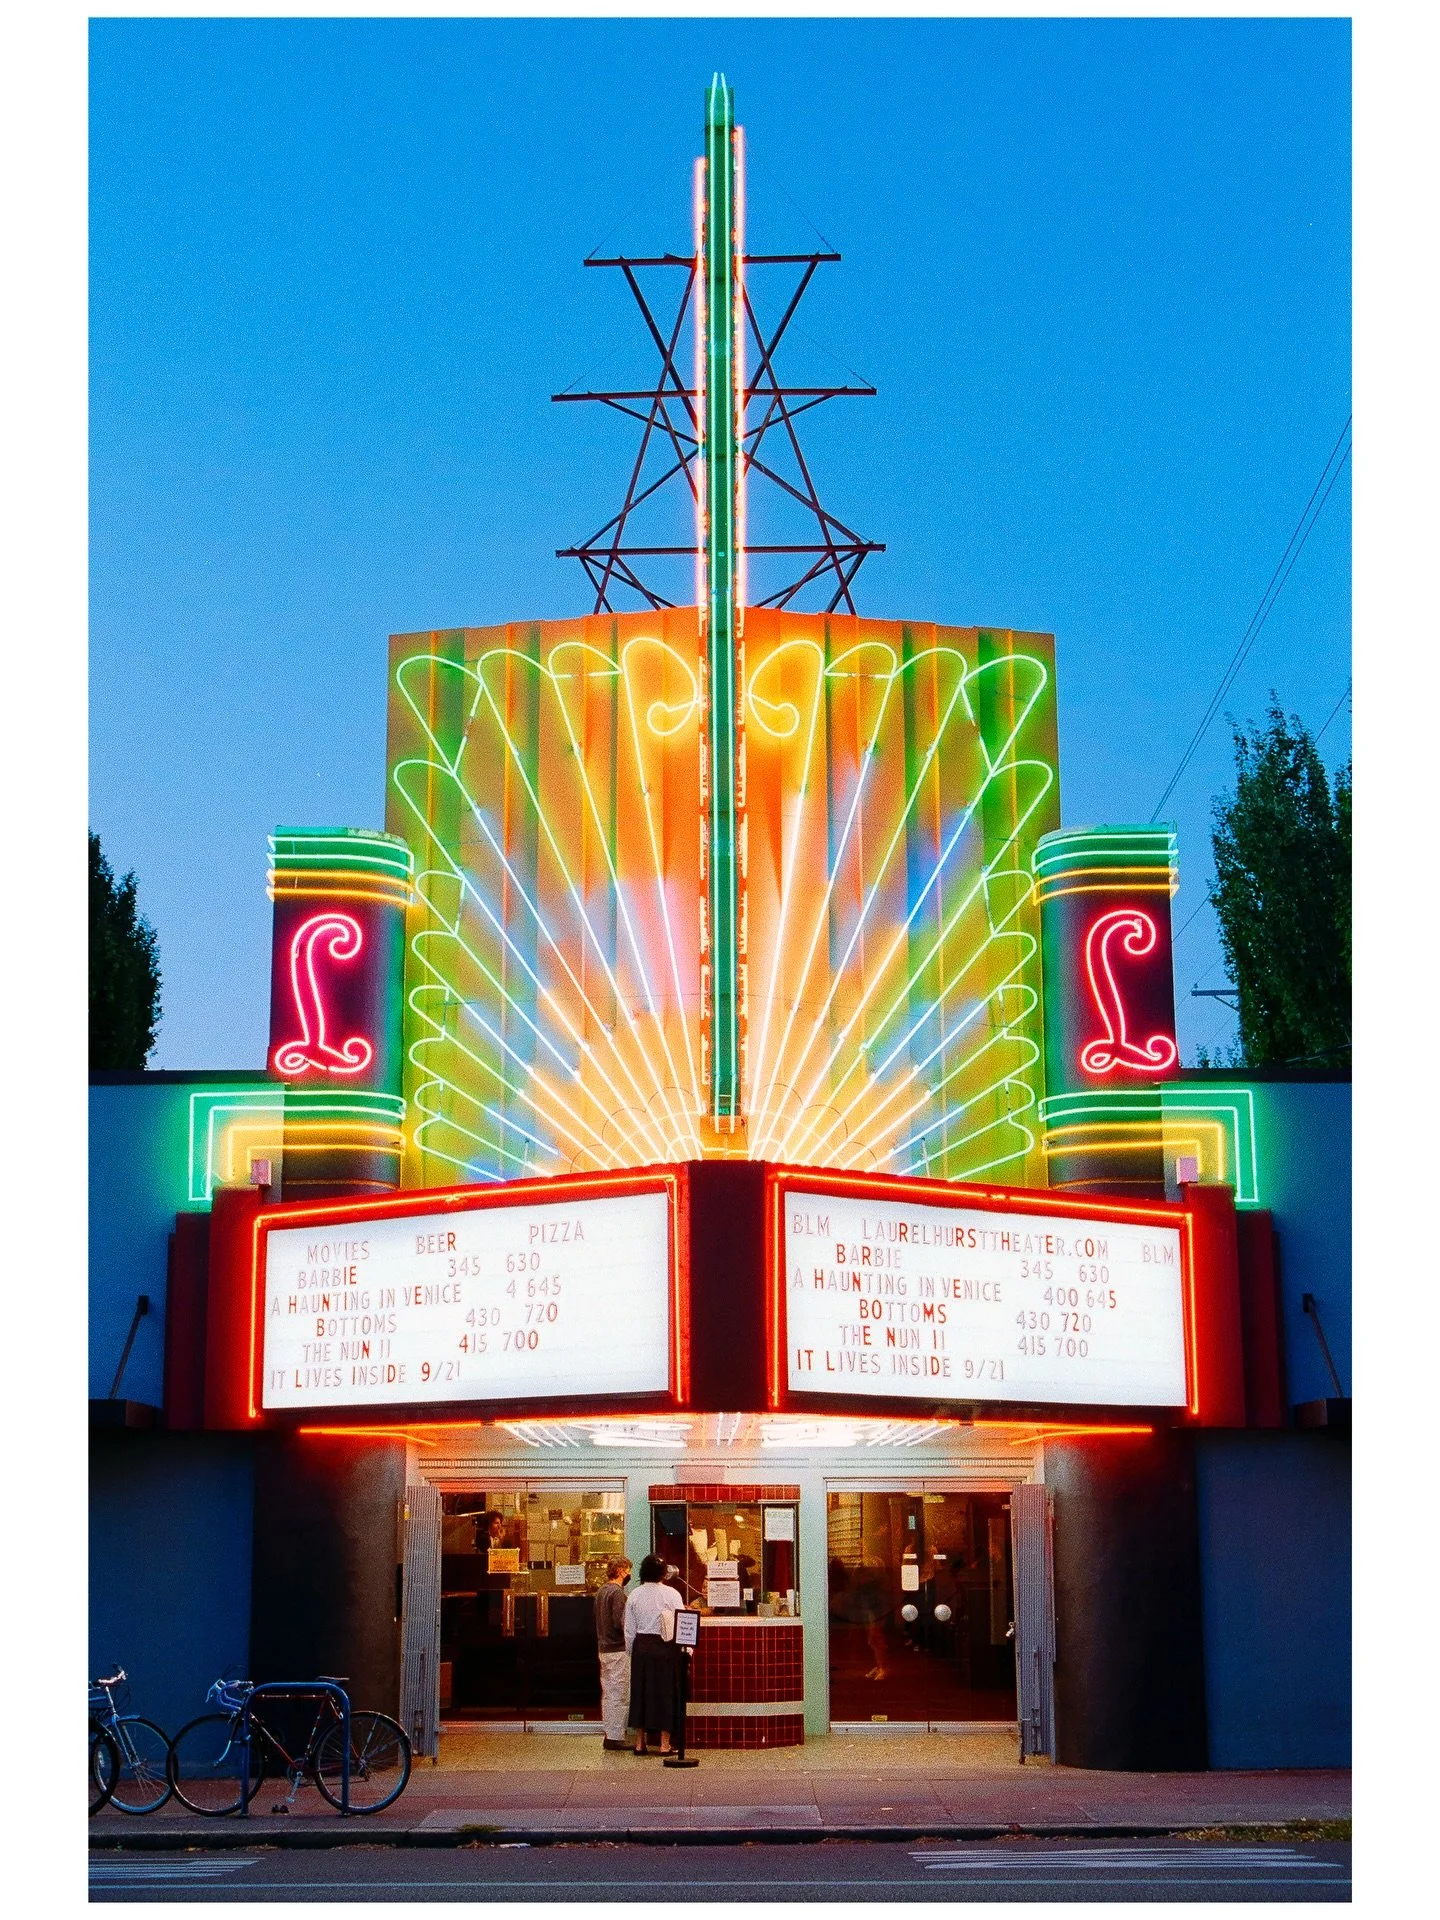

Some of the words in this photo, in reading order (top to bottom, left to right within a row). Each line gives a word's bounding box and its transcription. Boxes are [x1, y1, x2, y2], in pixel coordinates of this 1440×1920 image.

[274, 912, 372, 1074] L
[1081, 909, 1176, 1074] L
[307, 1240, 370, 1264] MOVIES
[415, 1232, 457, 1255] BEER
[528, 1219, 585, 1244] PIZZA
[793, 1213, 830, 1238] BLM
[862, 1218, 1109, 1260] LAURELHURSTTHEATER.COM
[1141, 1243, 1175, 1266] BLM
[297, 1265, 357, 1290] BARBIE
[447, 1255, 481, 1278] 345
[506, 1252, 541, 1273] 630
[836, 1243, 902, 1269] BARBIE
[1020, 1259, 1054, 1280] 345
[1079, 1264, 1110, 1284] 630
[271, 1296, 281, 1316] A
[288, 1290, 371, 1315] HAUNTING
[379, 1287, 396, 1309] IN
[404, 1283, 463, 1307] VENICE
[506, 1279, 516, 1299] 4
[527, 1274, 562, 1298] 645
[793, 1267, 804, 1290] A
[814, 1268, 908, 1296] HAUNTING
[919, 1275, 935, 1298] IN
[941, 1276, 1003, 1303] VENICE
[1043, 1286, 1079, 1308] 400
[1086, 1289, 1117, 1310] 645
[316, 1313, 398, 1337] BOTTOMS
[465, 1307, 501, 1328] 430
[525, 1301, 559, 1325] 720
[859, 1298, 948, 1325] BOTTOMS
[1016, 1310, 1051, 1331] 430
[1060, 1311, 1093, 1334] 720
[302, 1342, 332, 1365] THE
[340, 1338, 371, 1362] NUN
[459, 1333, 488, 1354] 415
[502, 1328, 539, 1352] 700
[839, 1324, 872, 1347] THE
[886, 1326, 921, 1350] NUN
[1016, 1336, 1047, 1357] 415
[1054, 1336, 1090, 1358] 700
[271, 1369, 286, 1390] IT
[295, 1365, 343, 1390] LIVES
[351, 1362, 408, 1387] INSIDE
[421, 1358, 462, 1383] 9/21
[796, 1348, 814, 1371] IT
[826, 1349, 881, 1375] LIVES
[891, 1353, 952, 1378] INSIDE
[964, 1358, 1005, 1381] 9/21
